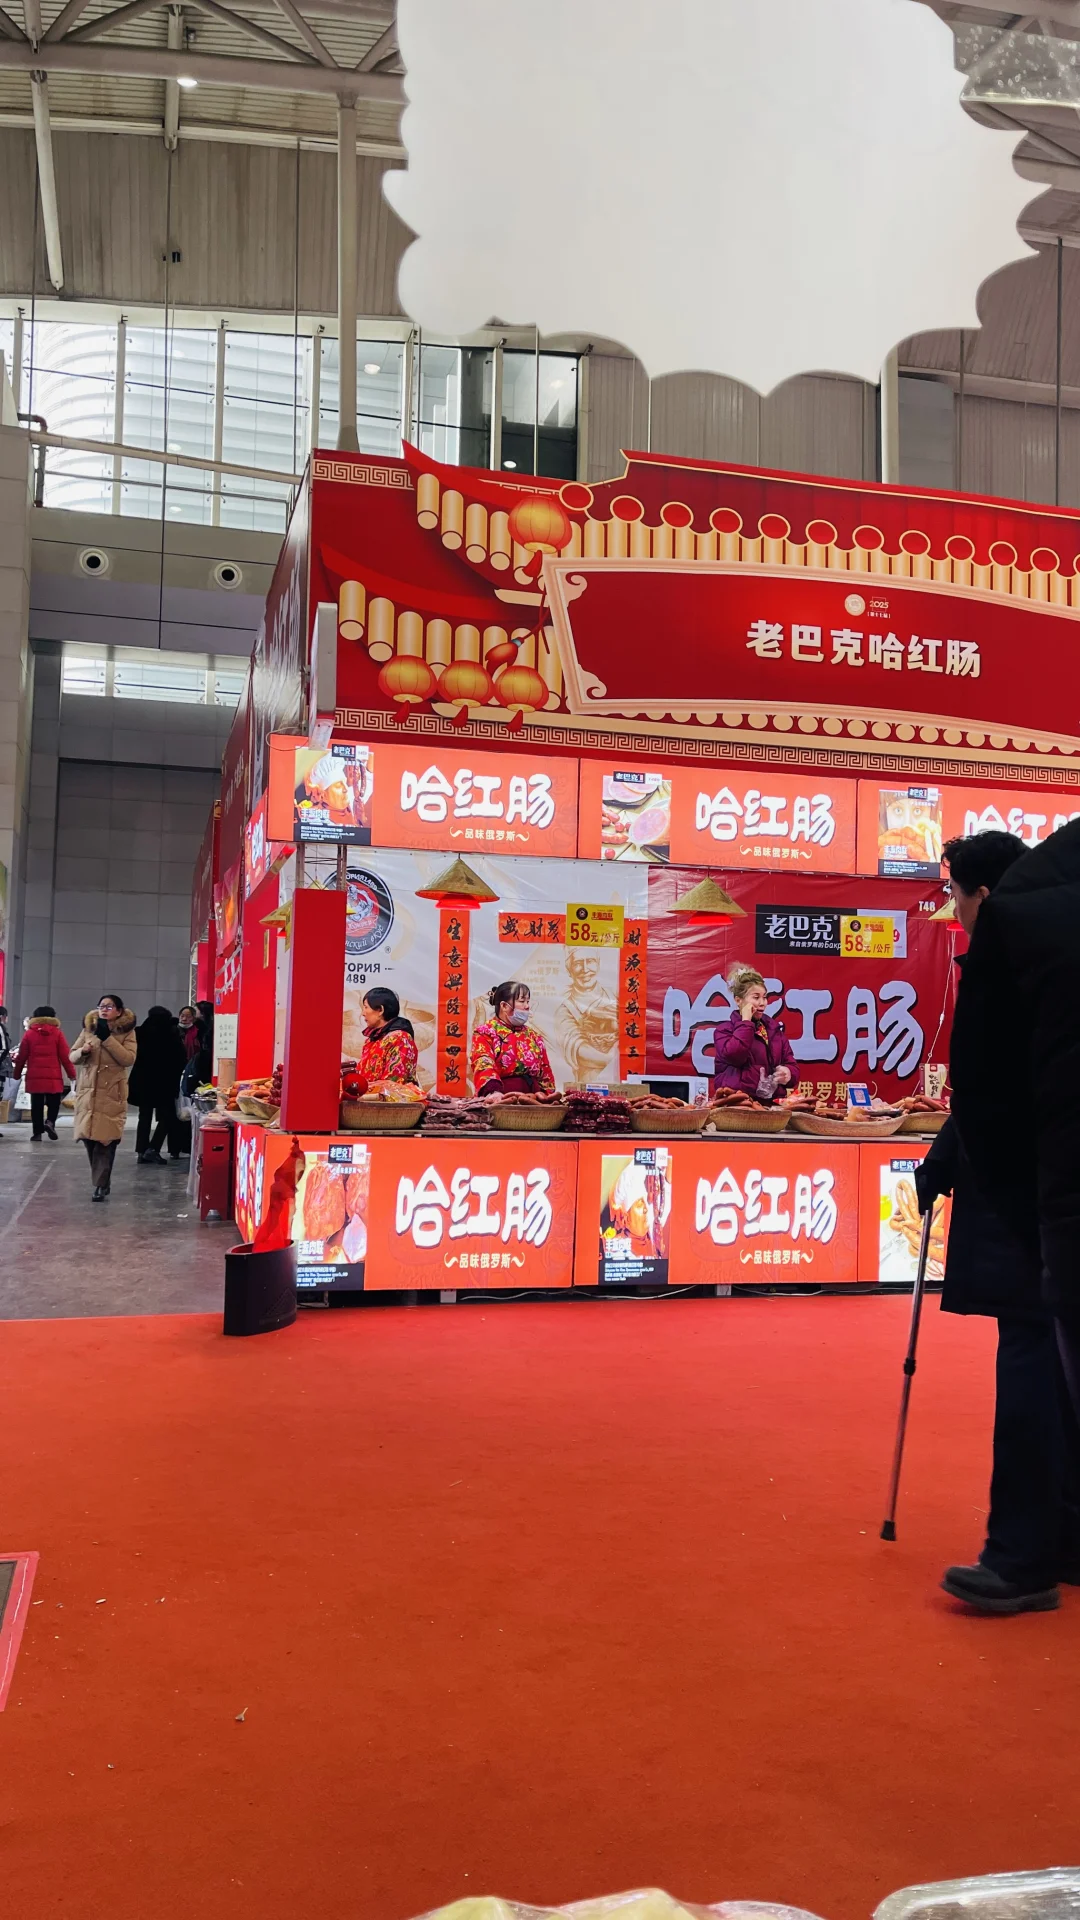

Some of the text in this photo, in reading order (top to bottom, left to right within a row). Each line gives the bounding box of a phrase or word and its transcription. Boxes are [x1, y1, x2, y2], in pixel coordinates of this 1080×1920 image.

[869, 600, 889, 609] 2025
[746, 619, 981, 678] 老巴克哈红肠
[400, 765, 555, 829] 哈红肠
[696, 786, 836, 847] 哈红肠
[764, 914, 834, 940] 老巴克
[918, 900, 936, 912] T48
[345, 973, 366, 984] 489
[396, 1164, 553, 1249] 哈红肠
[695, 1166, 838, 1246] 哈红肠
[459, 1253, 512, 1269] 品味俄罗斯
